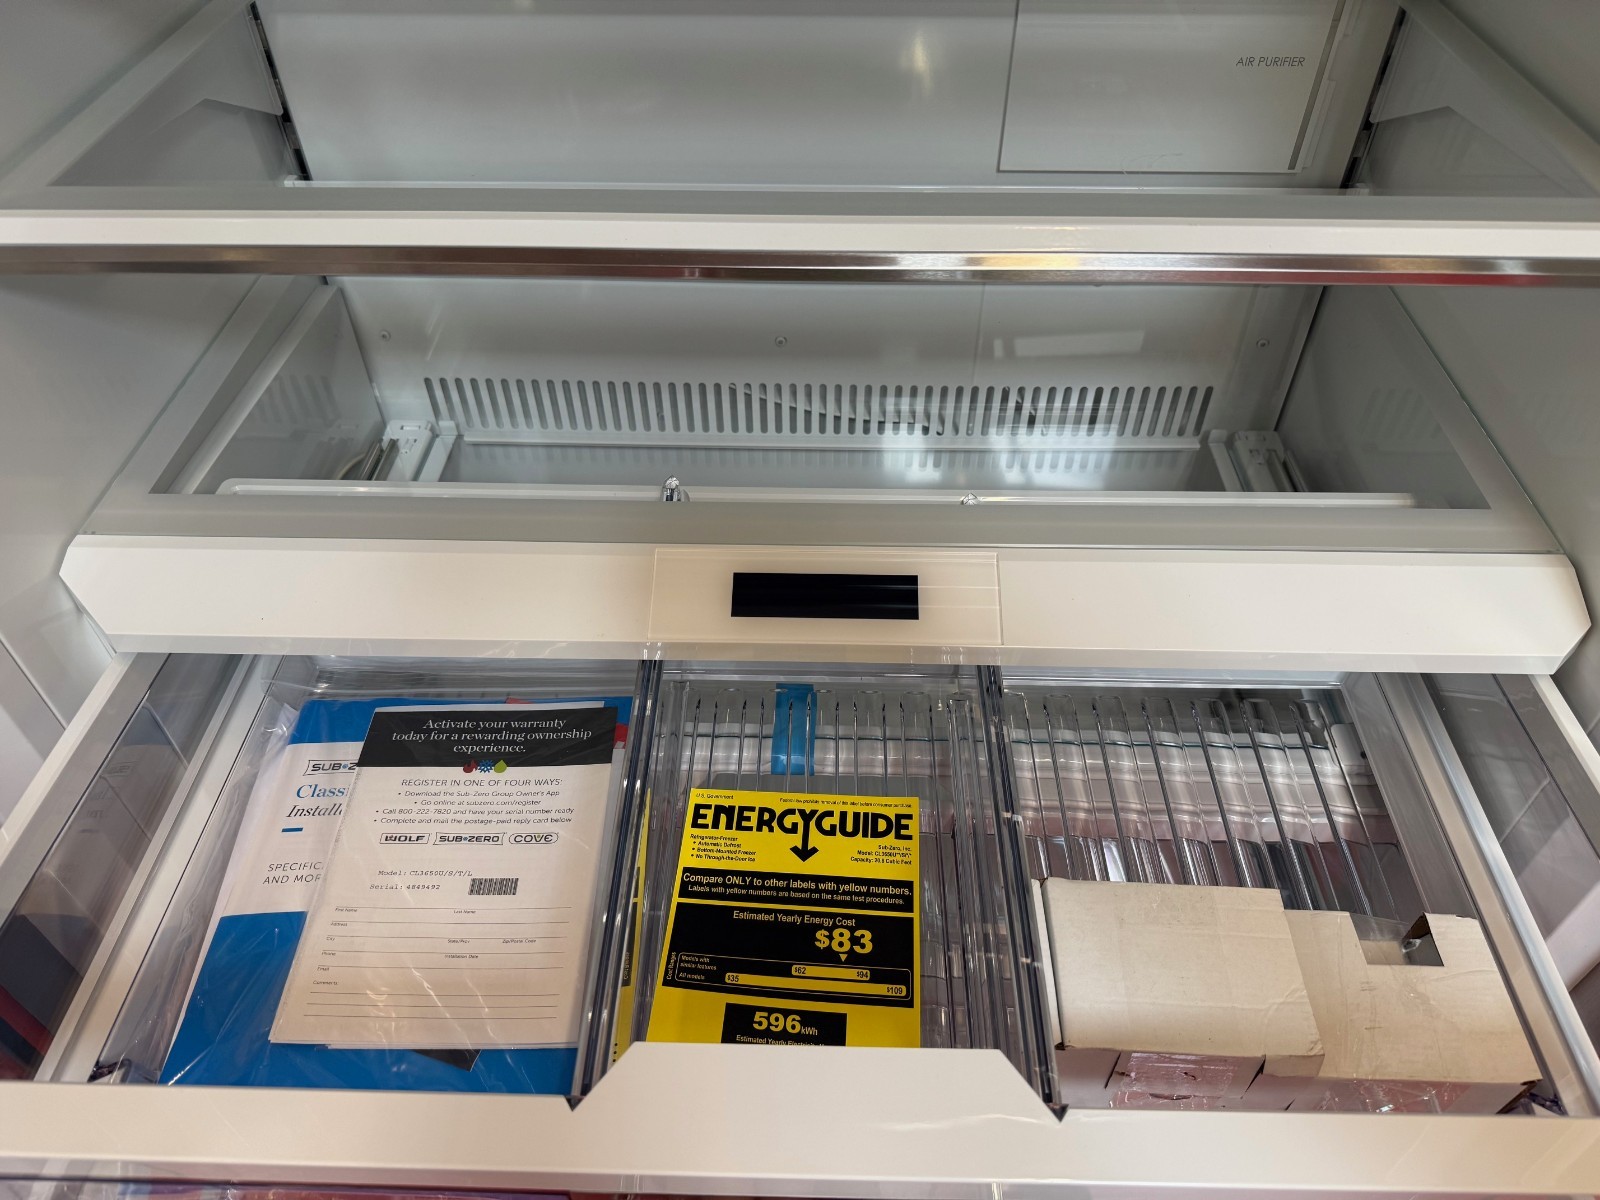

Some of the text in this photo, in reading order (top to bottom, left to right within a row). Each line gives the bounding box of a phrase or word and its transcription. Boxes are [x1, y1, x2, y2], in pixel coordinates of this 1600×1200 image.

[1236, 56, 1306, 67] AIR PURIFIER
[422, 719, 566, 730] Activate your warranty
[392, 729, 592, 742] today for a rewarding ownership
[453, 743, 526, 754] experience.
[401, 778, 563, 787] REGISTER IN ONE OF FOUR WAYS:
[554, 807, 575, 815] ready
[380, 817, 416, 825] Complete
[691, 803, 914, 840] ENERGYGUIDE
[513, 834, 553, 843] COVE
[267, 861, 324, 872] SPECIFIC
[262, 875, 290, 885] AND
[683, 872, 912, 896] Compare ONLY to other labels with yellow numbers.
[688, 884, 710, 892] Labels
[726, 887, 747, 895] yellow
[790, 890, 810, 898] based
[865, 896, 905, 905] procedures.
[733, 910, 856, 927] Estimated Yearly Energy Cost
[815, 927, 873, 954] $83
[794, 966, 807, 975] $62
[856, 970, 869, 979] $94
[727, 974, 740, 982] $35
[887, 986, 903, 995] $109
[752, 1011, 818, 1036] 596 kWh
[736, 1034, 767, 1044] Estimated
[767, 1038, 787, 1046] Yearly
